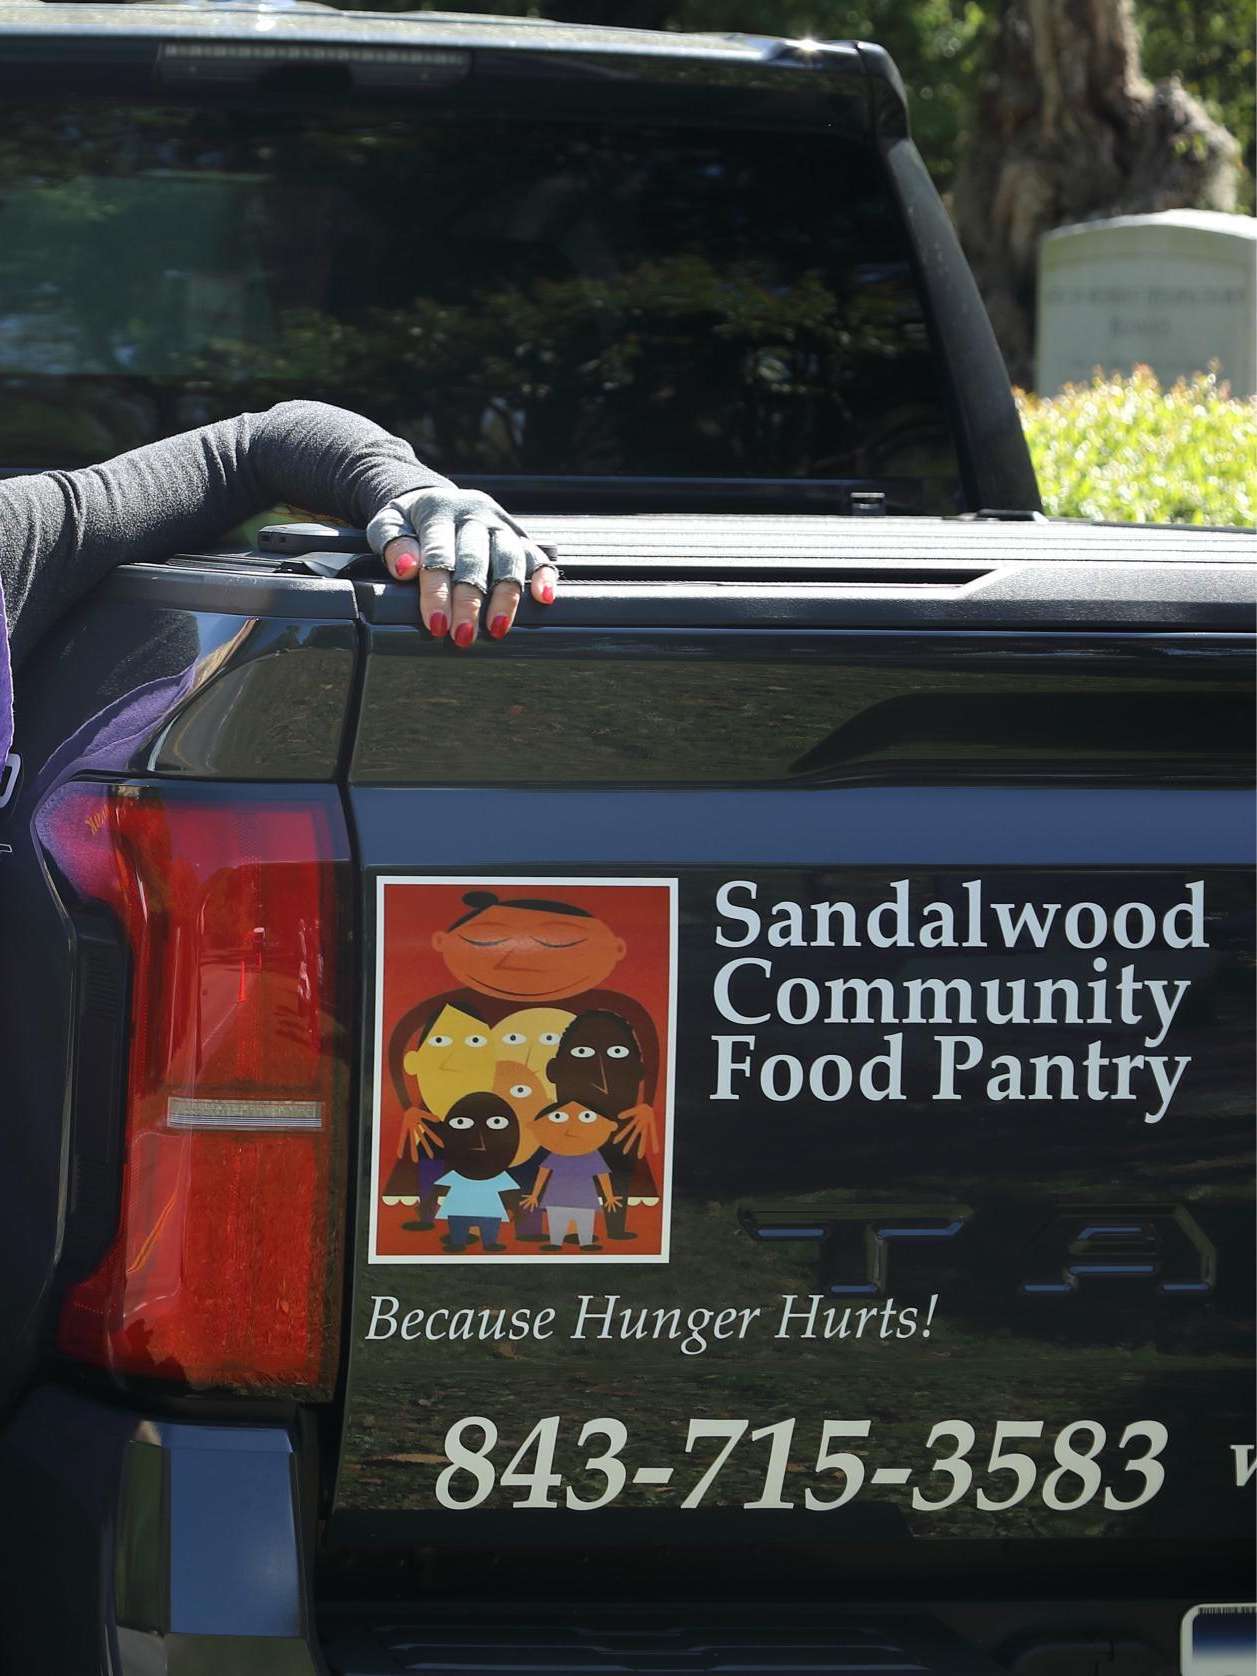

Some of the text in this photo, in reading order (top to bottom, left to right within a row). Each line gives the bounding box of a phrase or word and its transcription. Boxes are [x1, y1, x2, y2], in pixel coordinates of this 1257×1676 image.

[714, 879, 1210, 949] Sandalwood
[712, 957, 1192, 1048] Community
[709, 1034, 1192, 1124] Food Pantry
[364, 1293, 939, 1357] Because Hunger Hurts!
[434, 1415, 1170, 1512] 843-715-3583
